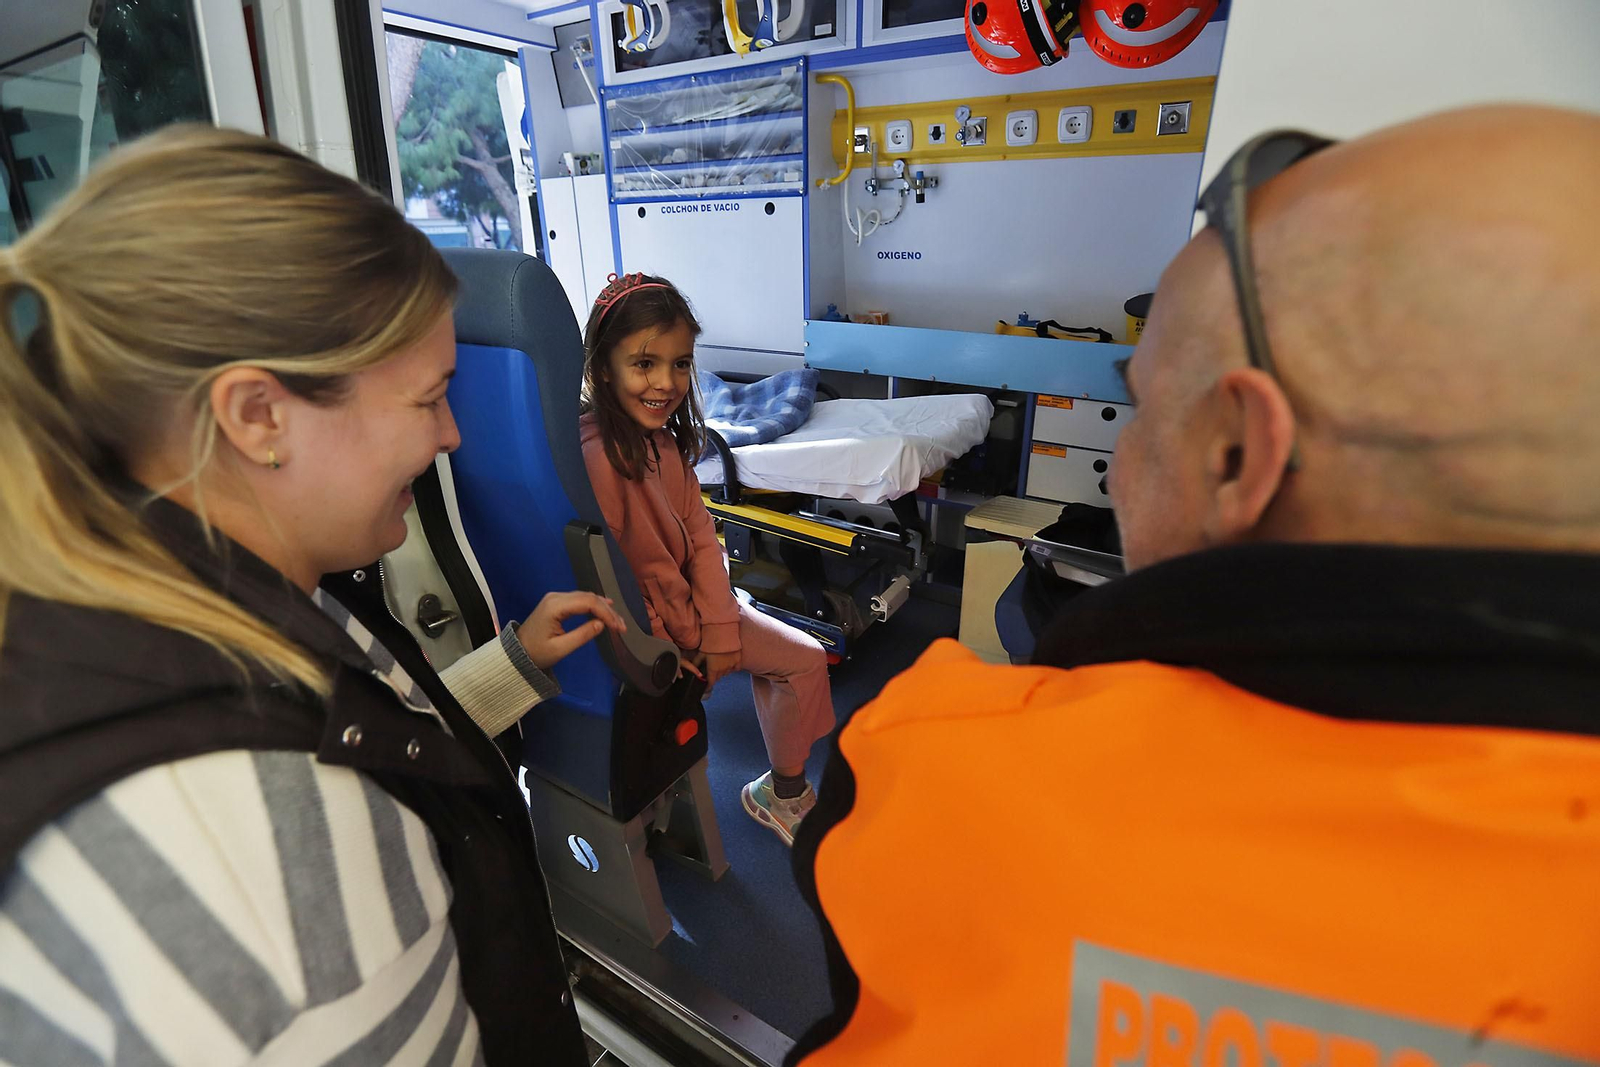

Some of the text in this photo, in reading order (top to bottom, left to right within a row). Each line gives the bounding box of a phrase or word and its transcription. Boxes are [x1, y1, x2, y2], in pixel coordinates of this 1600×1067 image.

[661, 202, 740, 214] COLCHON DE VACIO
[877, 251, 922, 260] OXIGENO
